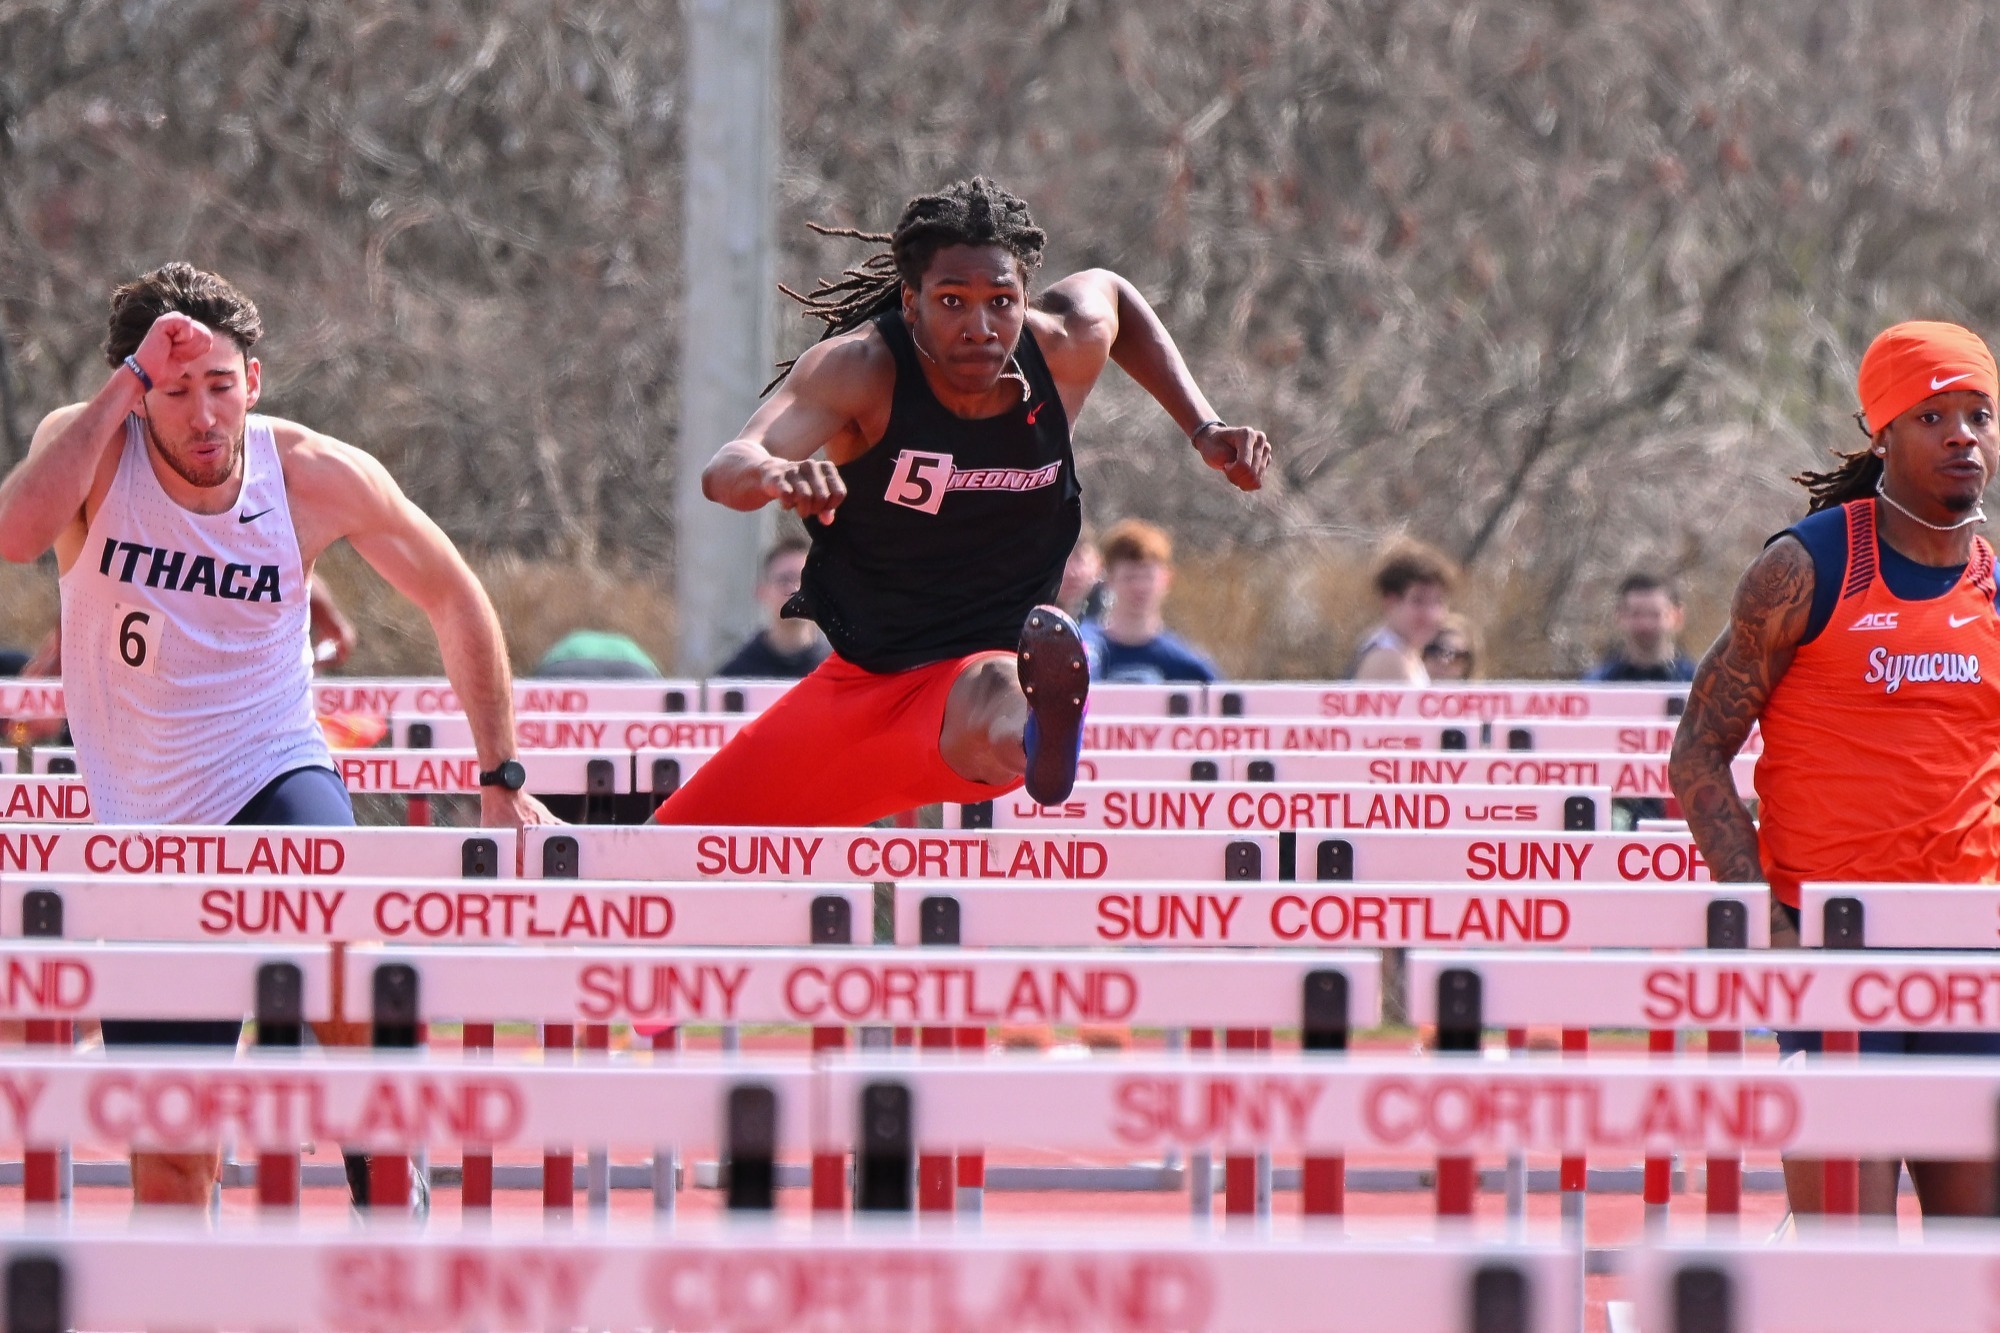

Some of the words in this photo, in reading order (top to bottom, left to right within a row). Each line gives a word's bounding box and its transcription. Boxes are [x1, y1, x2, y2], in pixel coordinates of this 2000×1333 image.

[897, 456, 940, 506] 5
[946, 462, 1059, 491] NEONTA
[99, 537, 282, 603] ITHACA
[119, 611, 150, 668] 6
[1849, 612, 1899, 631] ACC
[1864, 646, 1982, 694] Syracuse
[318, 689, 400, 716] SUNY
[1320, 692, 1403, 718] SUNY
[1417, 692, 1590, 718] CORTLAND
[517, 722, 607, 750] SUNY
[1171, 726, 1351, 750] CORTLAND
[1369, 760, 1468, 784] SUNY
[1102, 791, 1215, 829] SUNY
[1227, 792, 1451, 830] CORTLAND
[1465, 805, 1539, 822] UCS
[84, 834, 346, 875] CORTLAND
[696, 835, 824, 876] SUNY
[846, 837, 1109, 881] CORTLAND
[1465, 841, 1594, 881] SUNY
[200, 889, 346, 935] SUNY
[374, 890, 675, 939] CORTLAND
[1096, 894, 1242, 941] SUNY
[1269, 895, 1571, 942] CORTLAND
[577, 963, 751, 1018] SUNY
[783, 965, 1139, 1021] CORTLAND
[1642, 969, 1816, 1023] SUNY
[85, 1073, 526, 1144] CORTLAND
[1112, 1077, 1328, 1145] SUNY
[1361, 1078, 1803, 1149] CORTLAND
